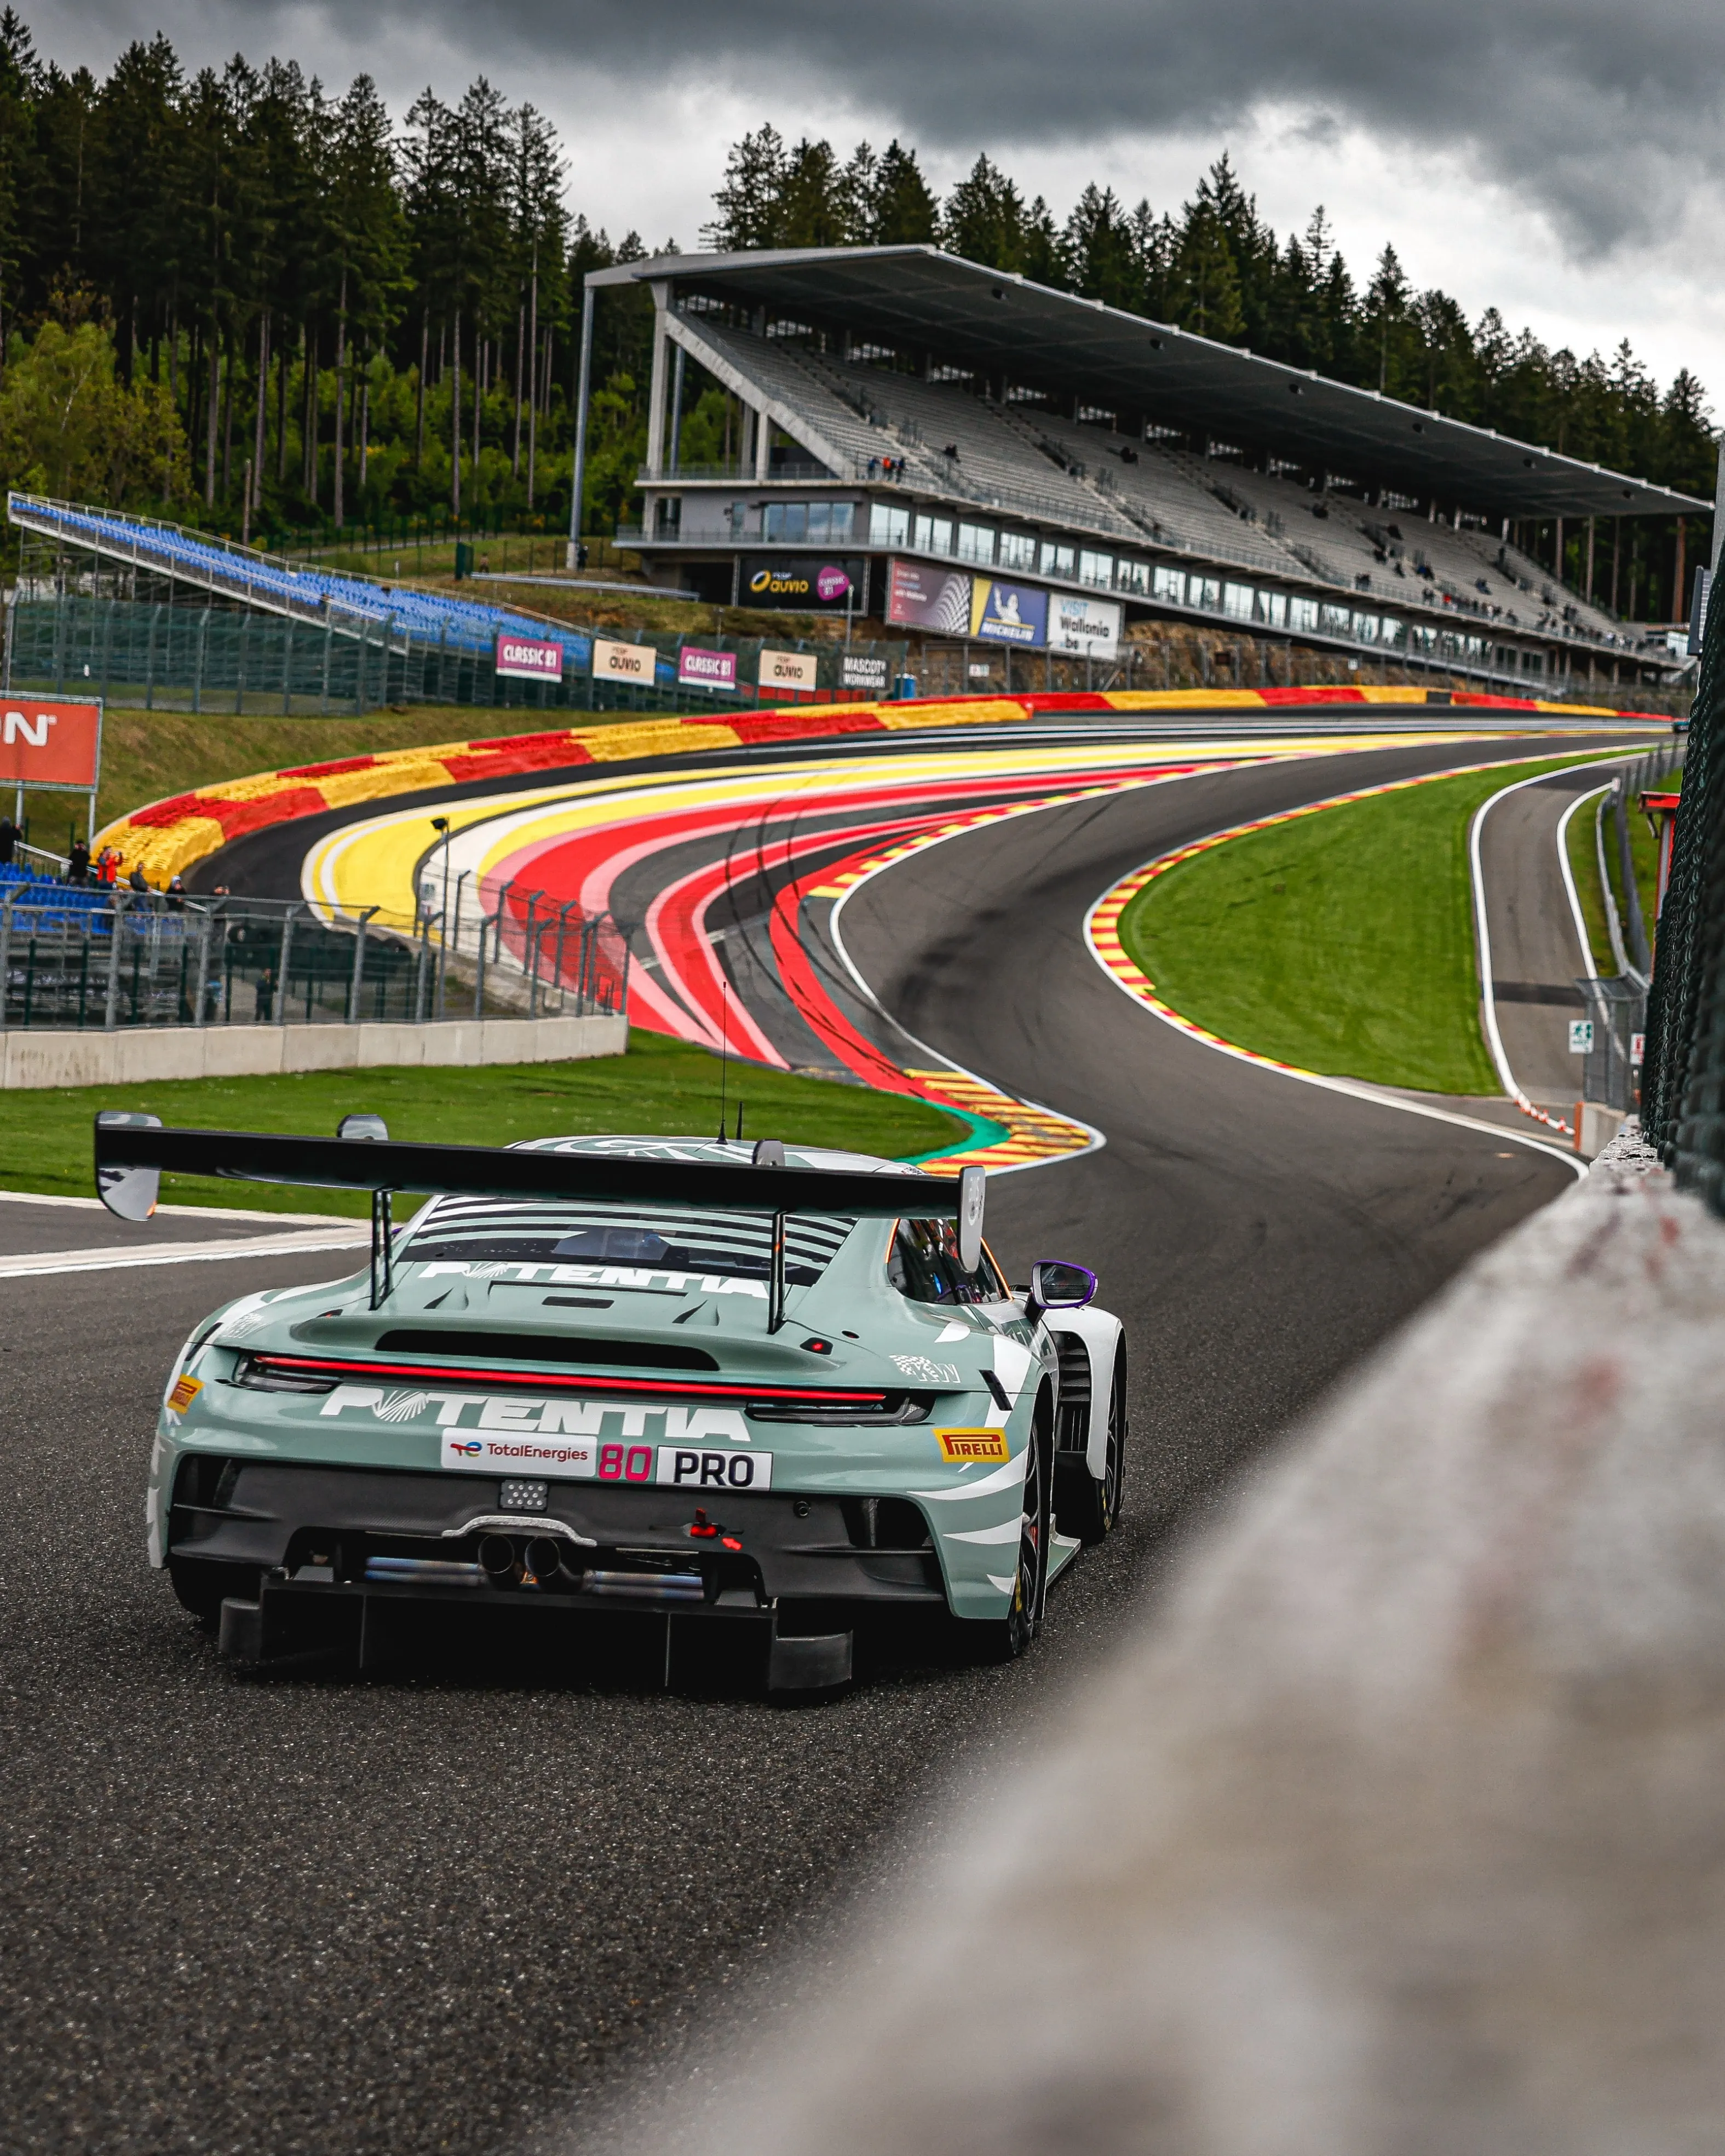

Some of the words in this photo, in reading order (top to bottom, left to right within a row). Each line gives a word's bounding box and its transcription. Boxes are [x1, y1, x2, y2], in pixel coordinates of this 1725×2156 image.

[981, 622, 1035, 641] MICHELIN
[1060, 616, 1109, 637] Wallonia
[503, 644, 544, 666] CLASSIC
[609, 656, 641, 672] auvio
[685, 655, 720, 675] CLASSIC
[773, 664, 803, 679] auvio
[418, 1261, 770, 1300] POTENTIA
[319, 1385, 751, 1442] POTENTIA
[941, 1434, 1003, 1456] PIRELLI
[486, 1441, 589, 1463] TotalEnergies
[598, 1442, 652, 1482] 80
[674, 1451, 755, 1488] PRO
